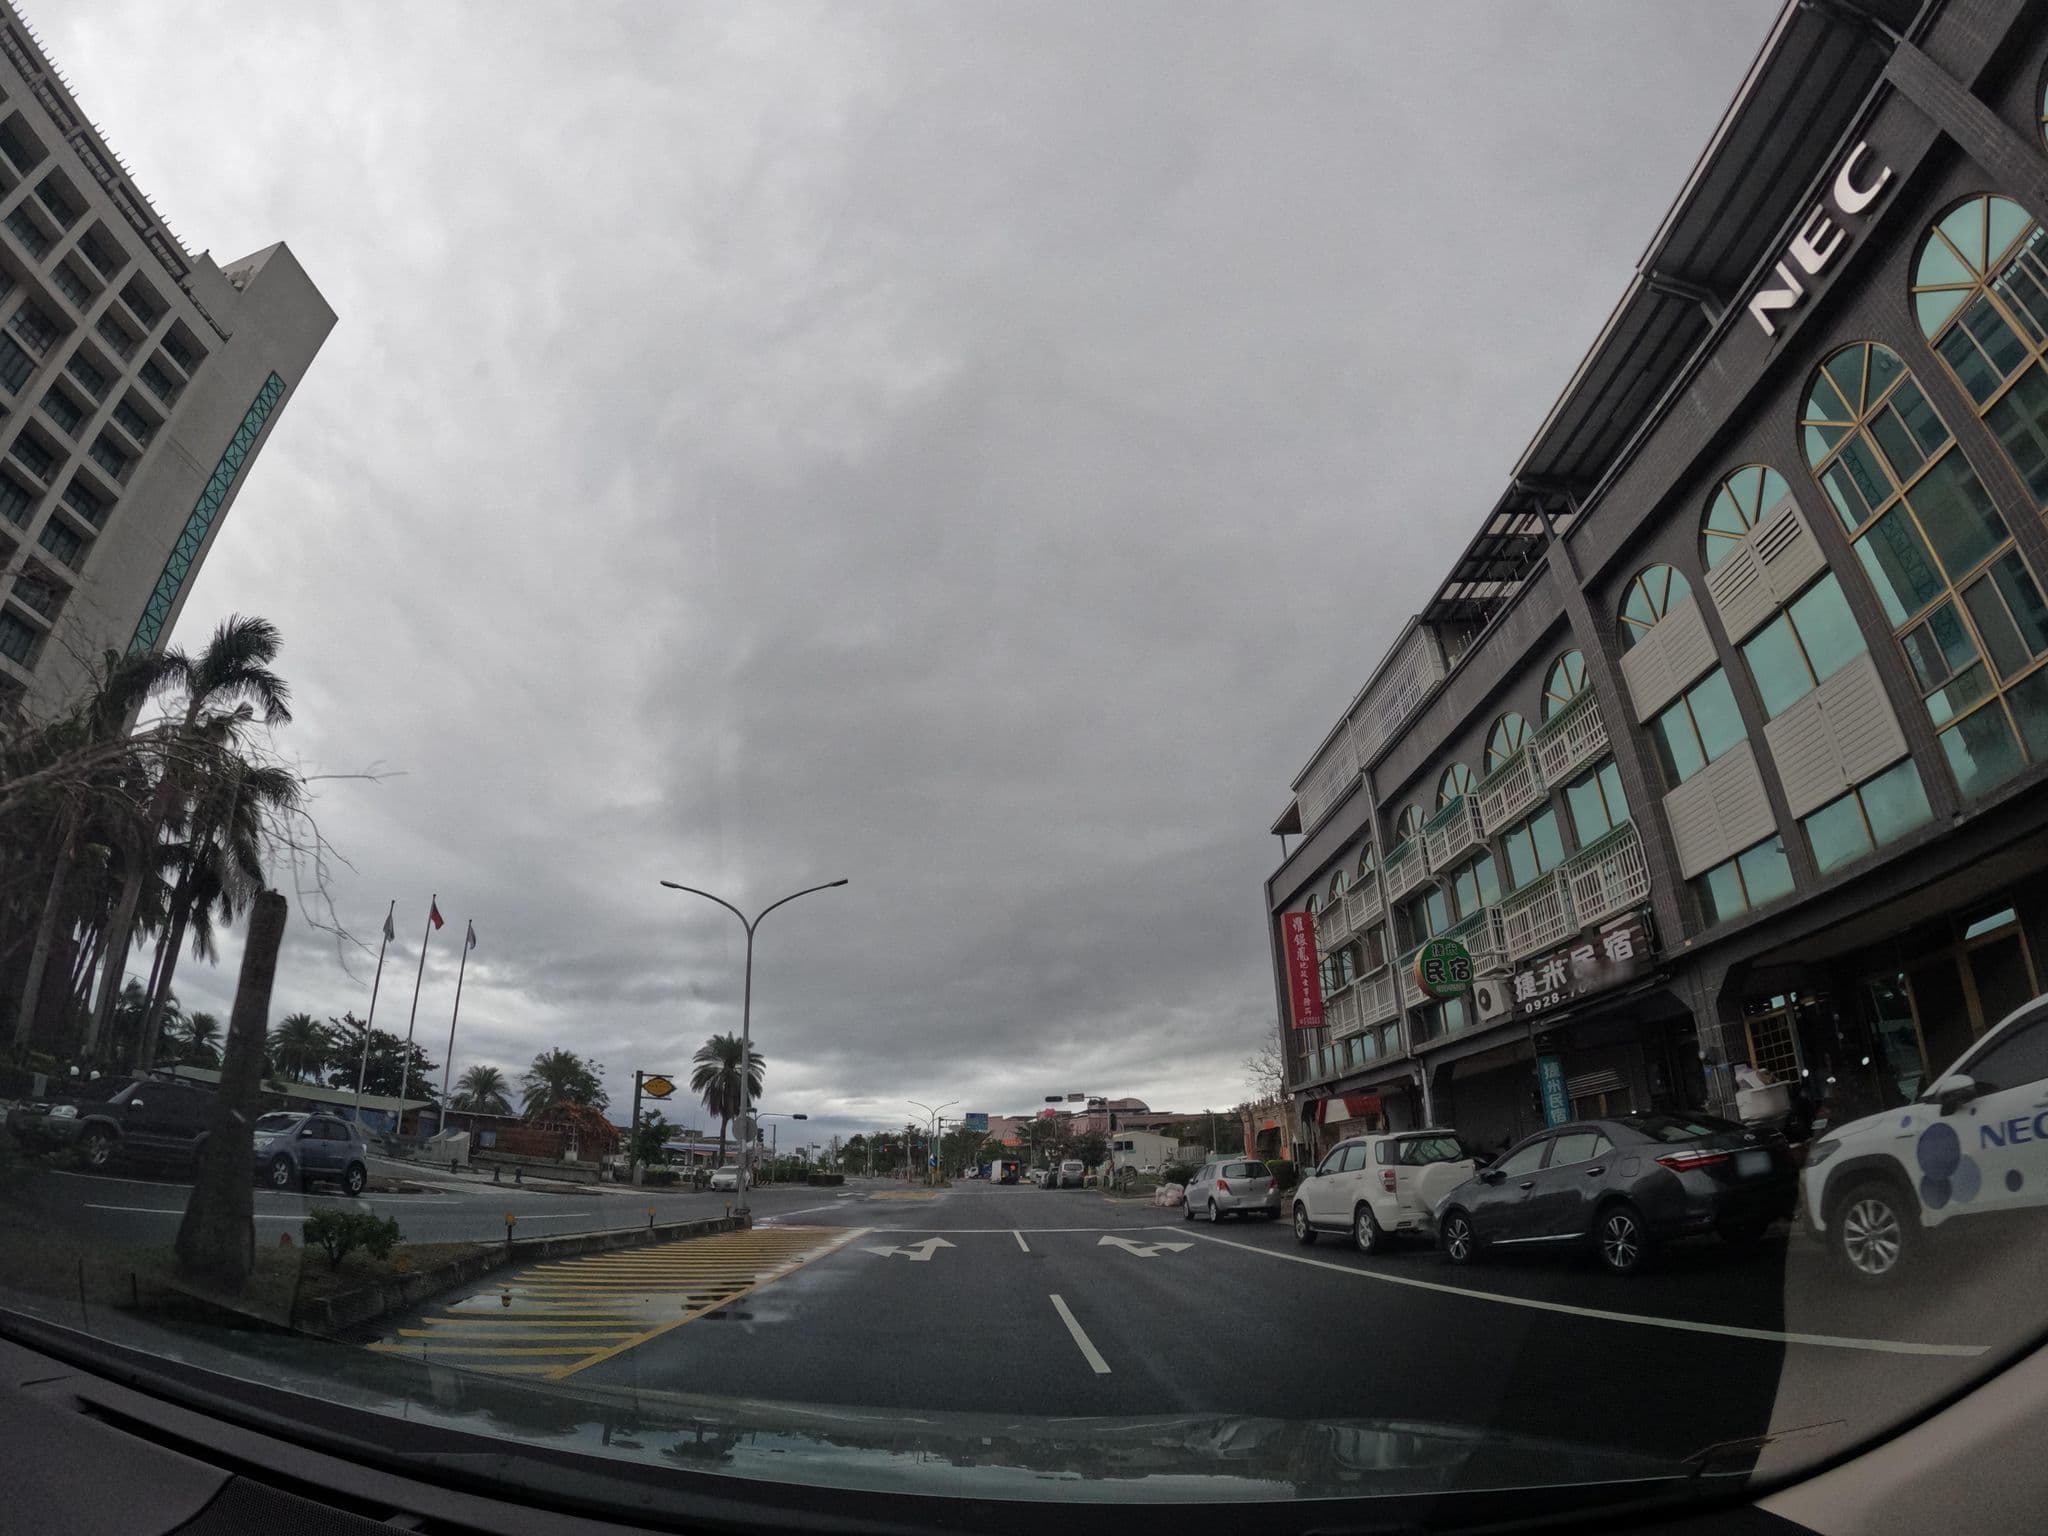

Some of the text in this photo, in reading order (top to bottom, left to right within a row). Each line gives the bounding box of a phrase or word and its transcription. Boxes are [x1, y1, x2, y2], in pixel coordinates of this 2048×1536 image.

[1748, 140, 1893, 337] NEC
[1424, 956, 1472, 984] 民宿
[1980, 1111, 2048, 1149] NEC
